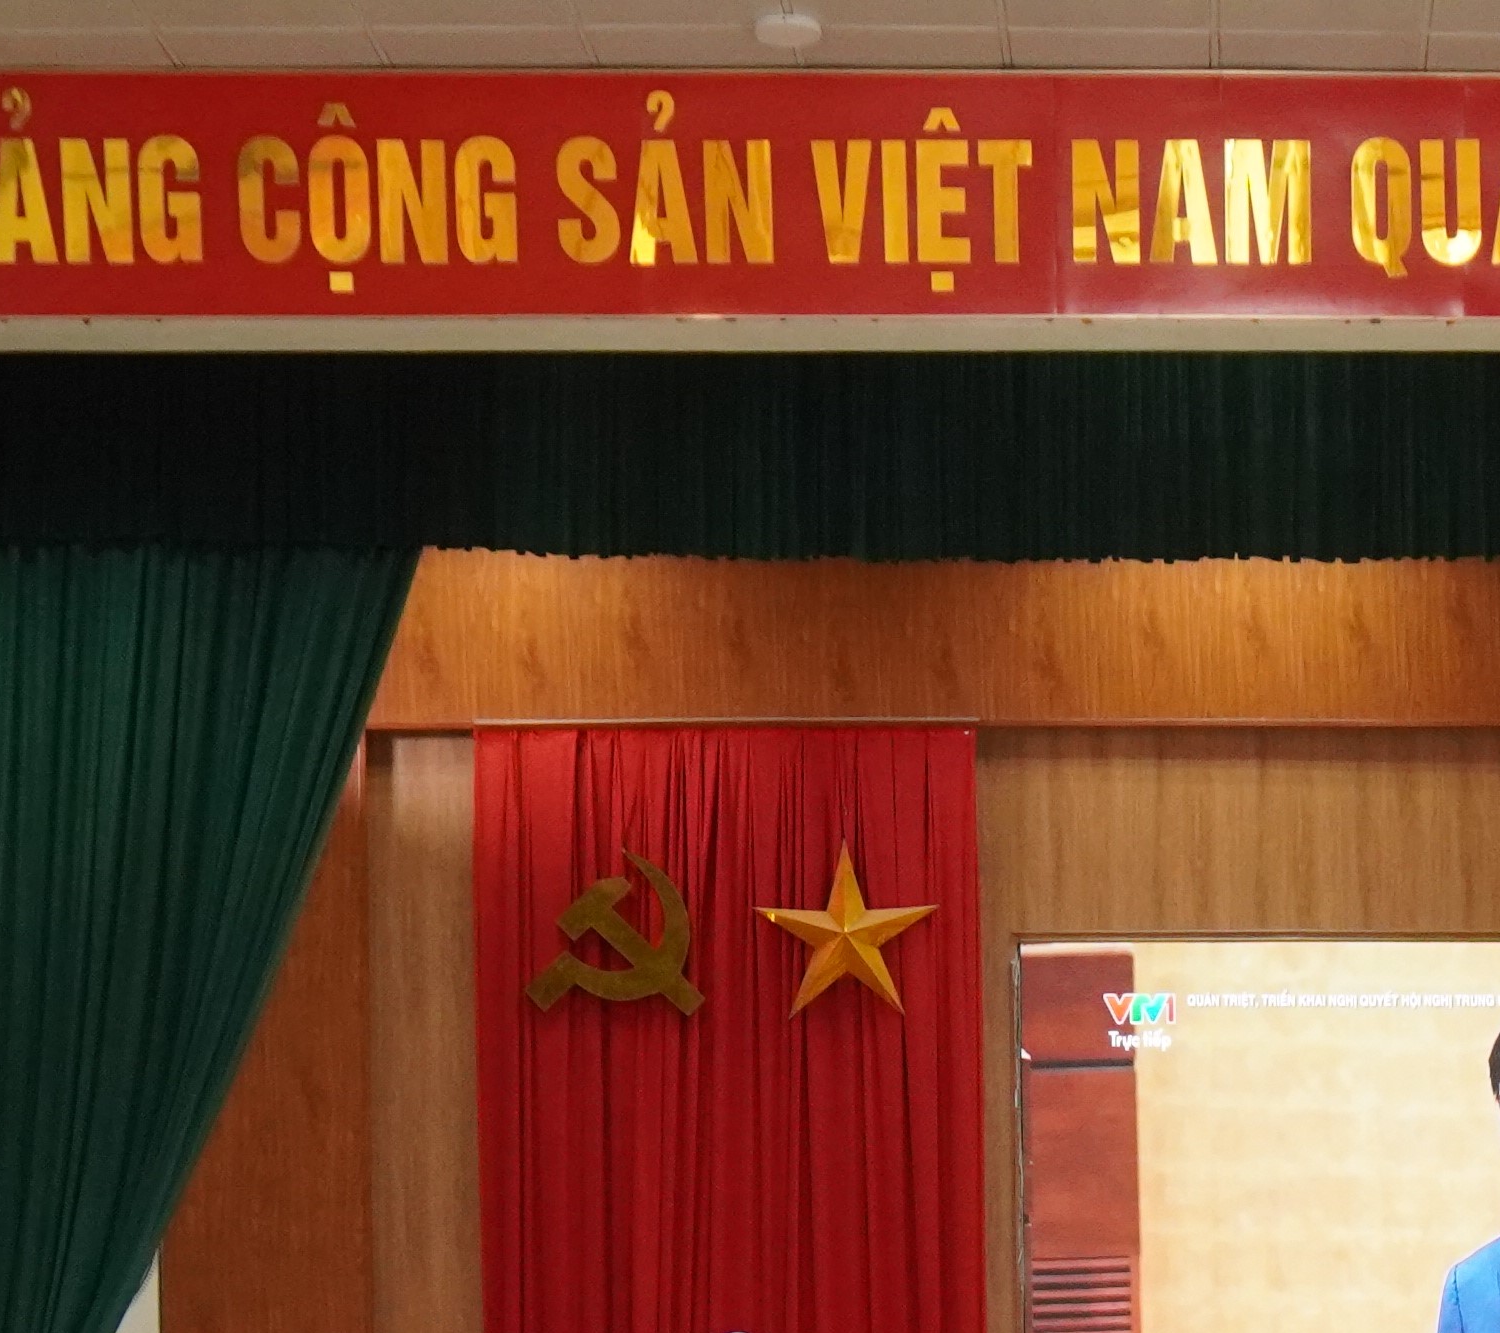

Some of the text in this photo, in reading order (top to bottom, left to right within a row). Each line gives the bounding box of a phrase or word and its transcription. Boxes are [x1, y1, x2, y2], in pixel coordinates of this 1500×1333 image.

[237, 101, 519, 295] CỘNG
[556, 89, 775, 268] SẢN
[811, 106, 1035, 294] VIỆT
[1071, 137, 1312, 266] NAM
[1102, 992, 1177, 1026] VTV1
[1107, 1027, 1173, 1052] Trực tiếp
